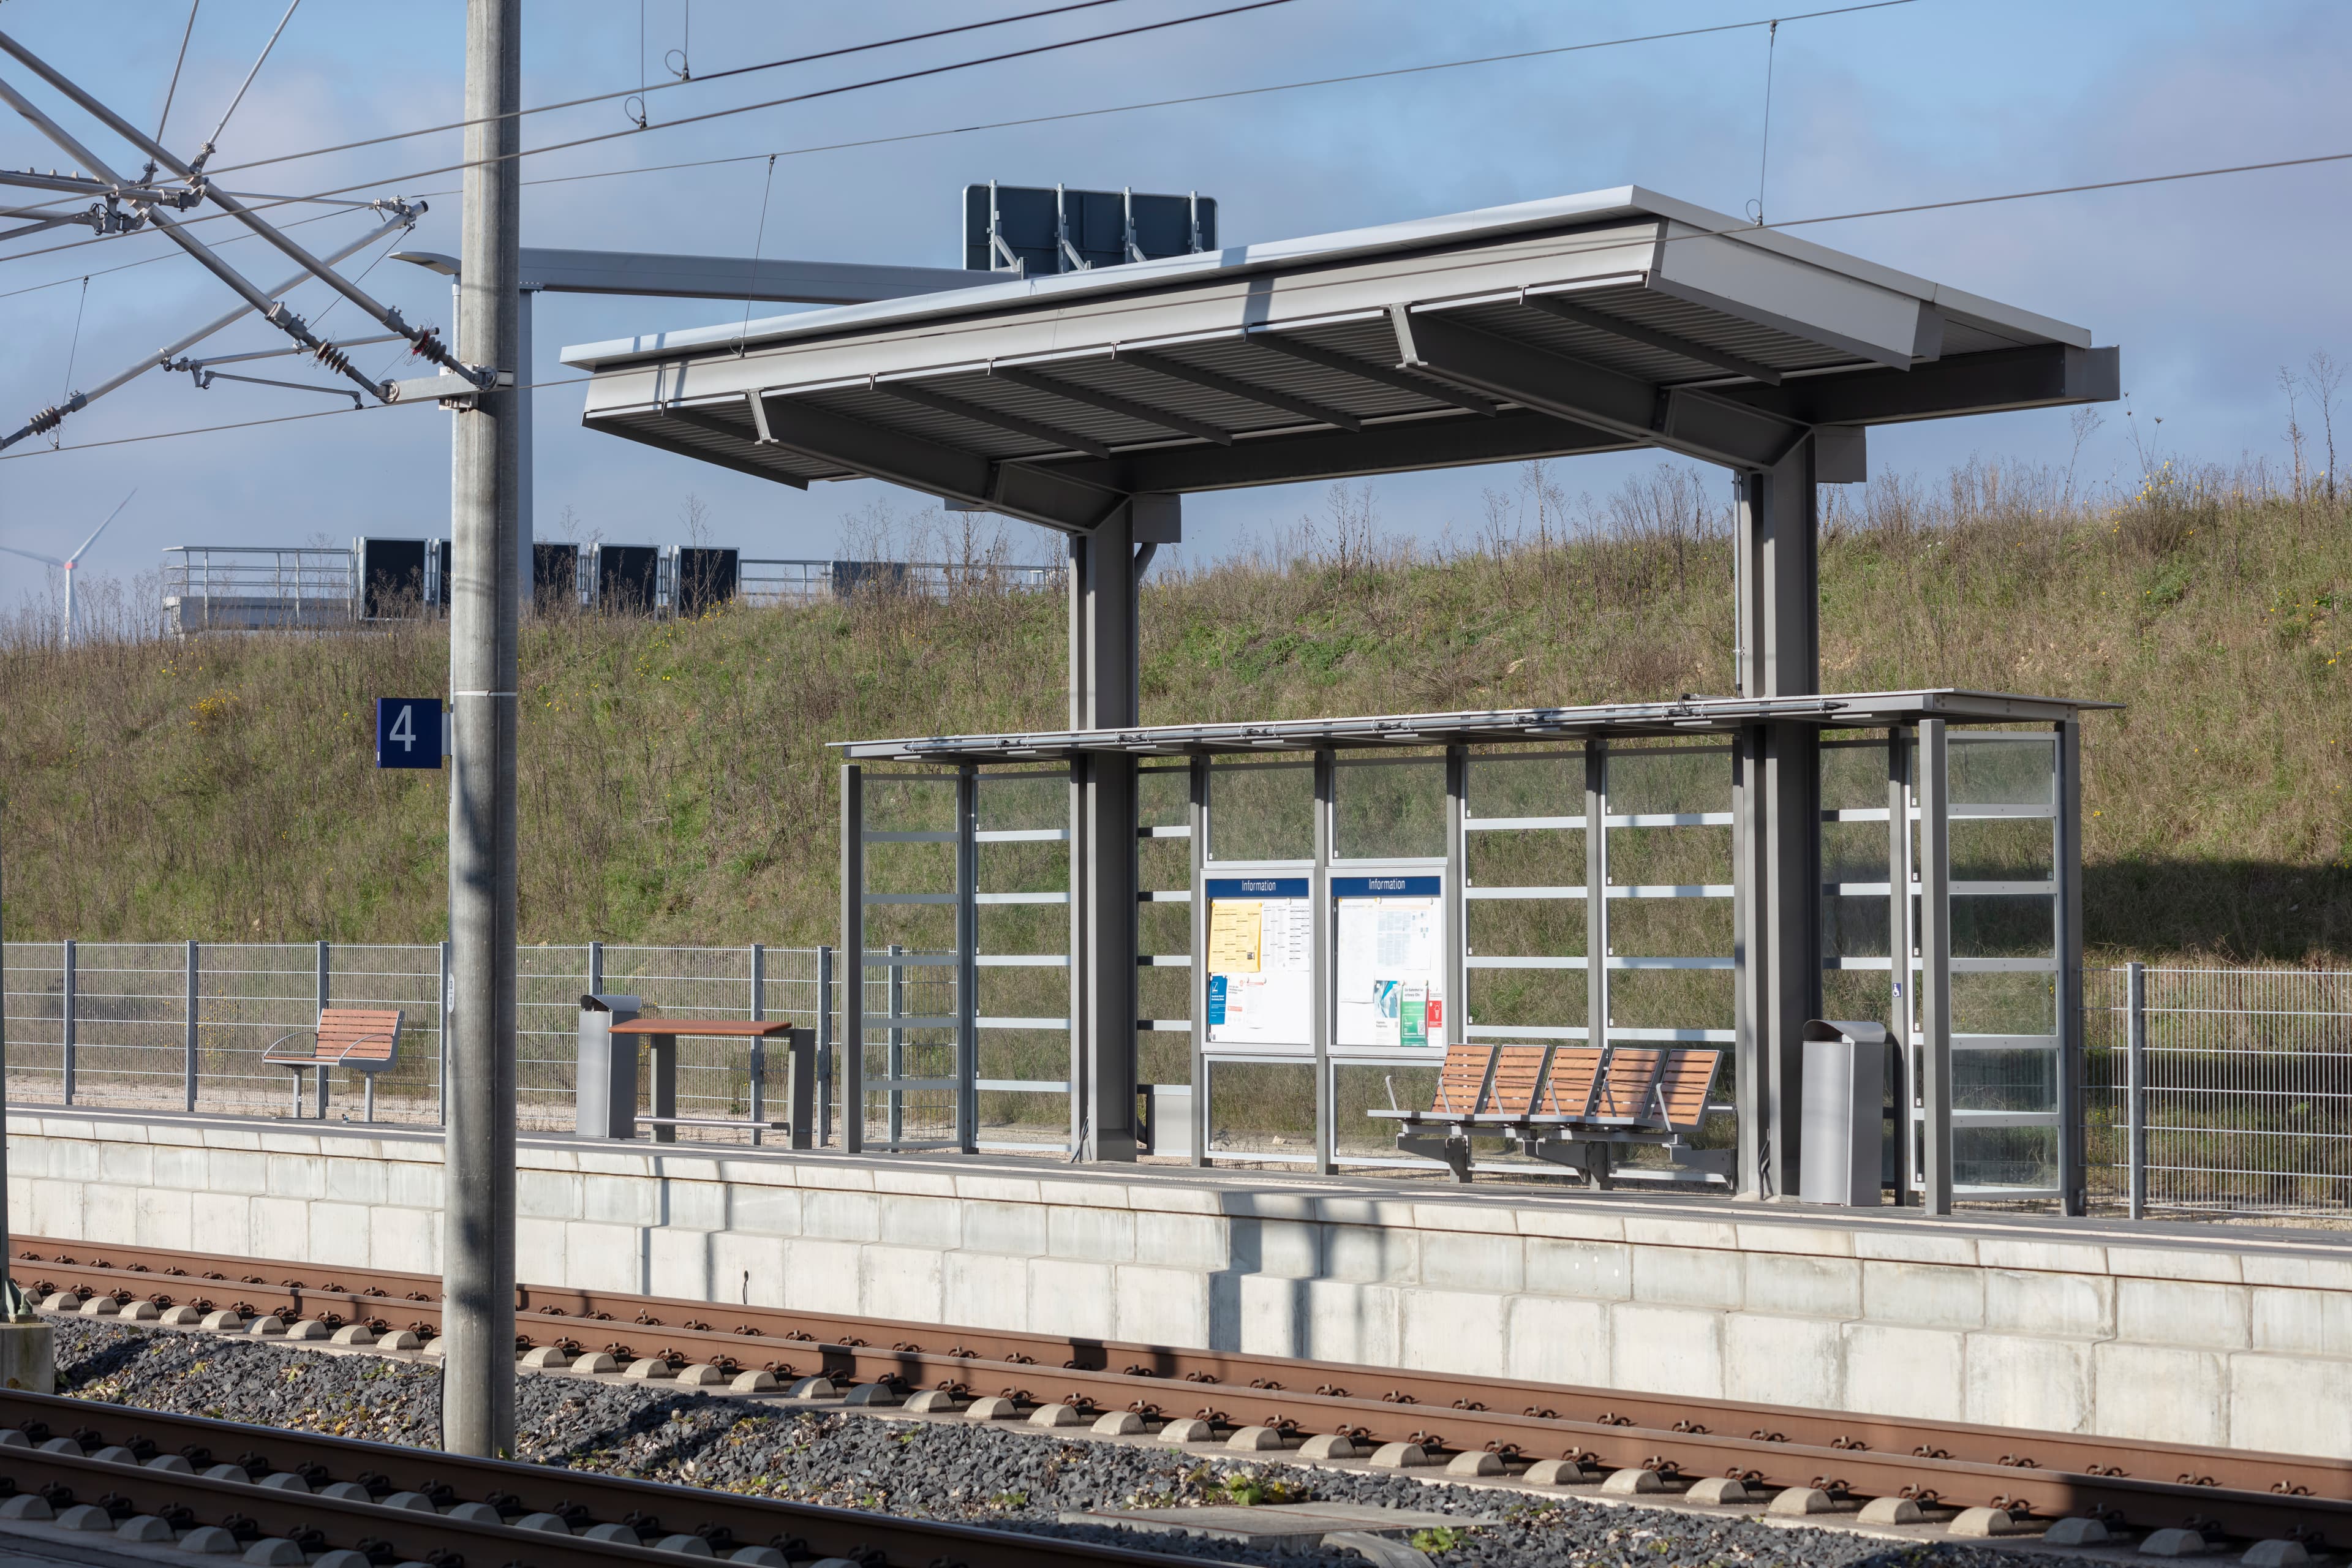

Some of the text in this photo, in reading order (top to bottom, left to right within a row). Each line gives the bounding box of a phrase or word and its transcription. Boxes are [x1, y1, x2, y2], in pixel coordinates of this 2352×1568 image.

[390, 706, 416, 752] 4
[1242, 880, 1276, 891] Information
[1369, 878, 1405, 890] Information
